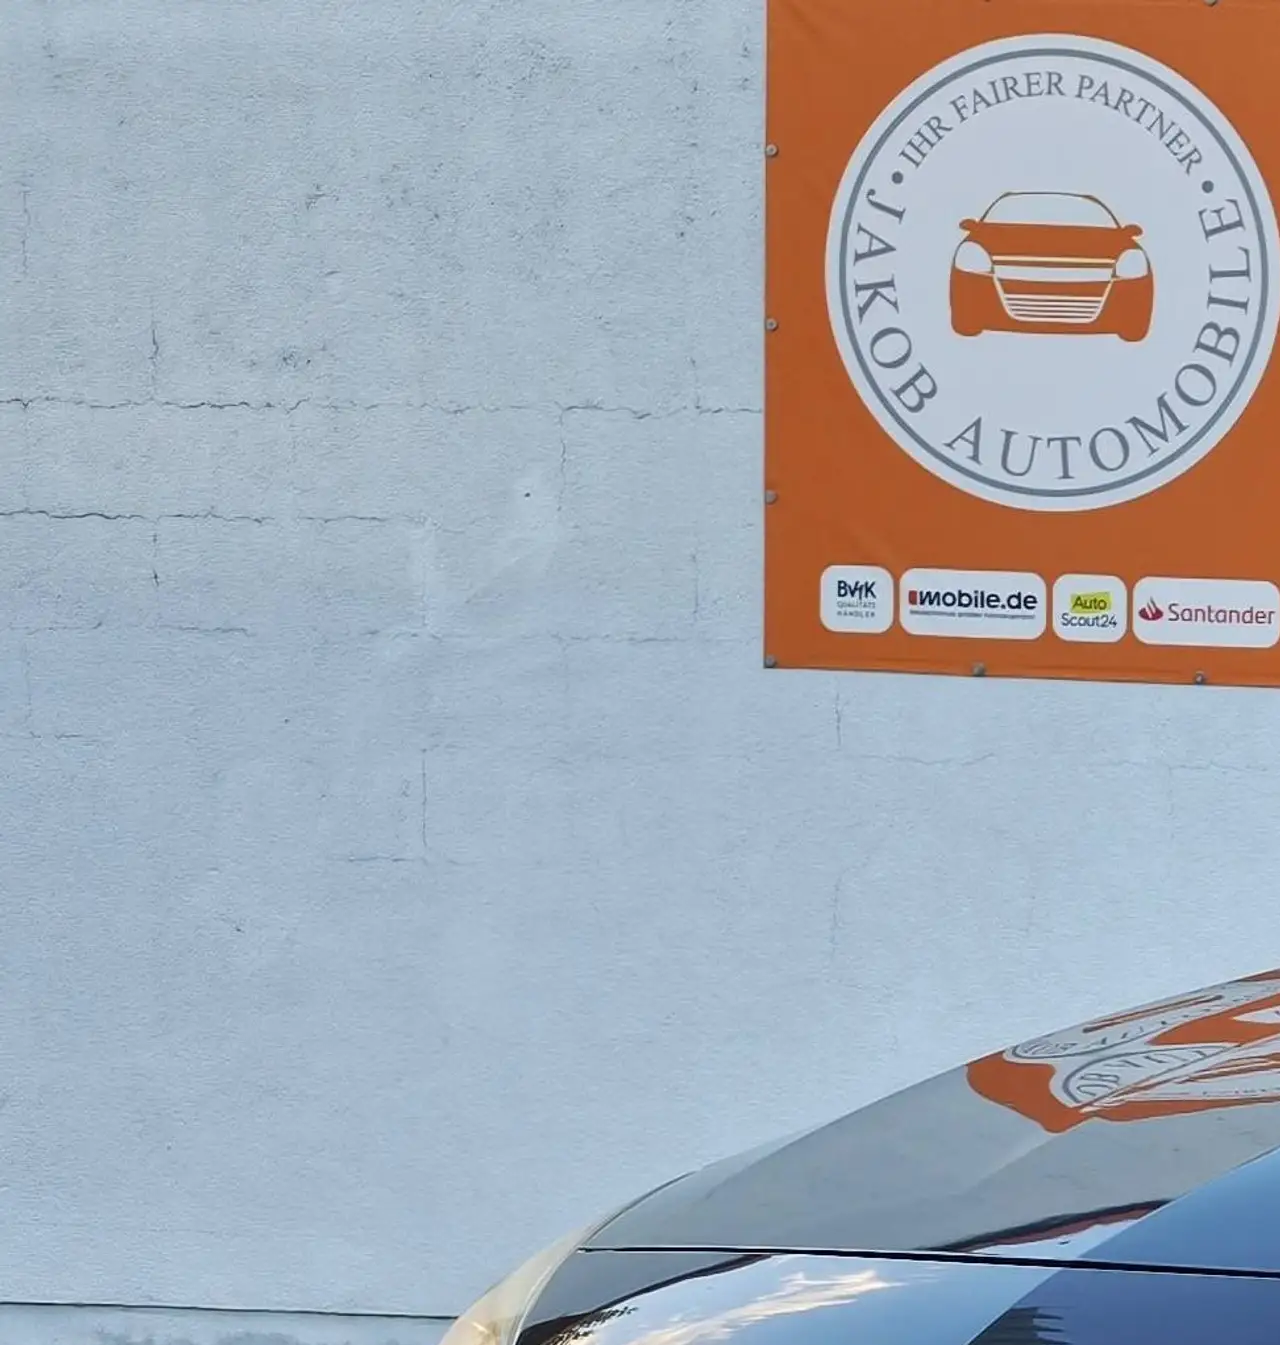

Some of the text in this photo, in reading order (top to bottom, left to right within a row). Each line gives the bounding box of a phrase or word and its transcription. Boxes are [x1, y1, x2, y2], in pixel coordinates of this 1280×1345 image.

[899, 70, 1204, 175] IHR FAIRER PARTNER
[853, 188, 1250, 480] JAKOB AUTOMOBILE
[919, 590, 1038, 610] mobile.de
[1073, 596, 1107, 610] Auto
[1061, 613, 1117, 627] Scout24
[1168, 603, 1275, 625] Santander
